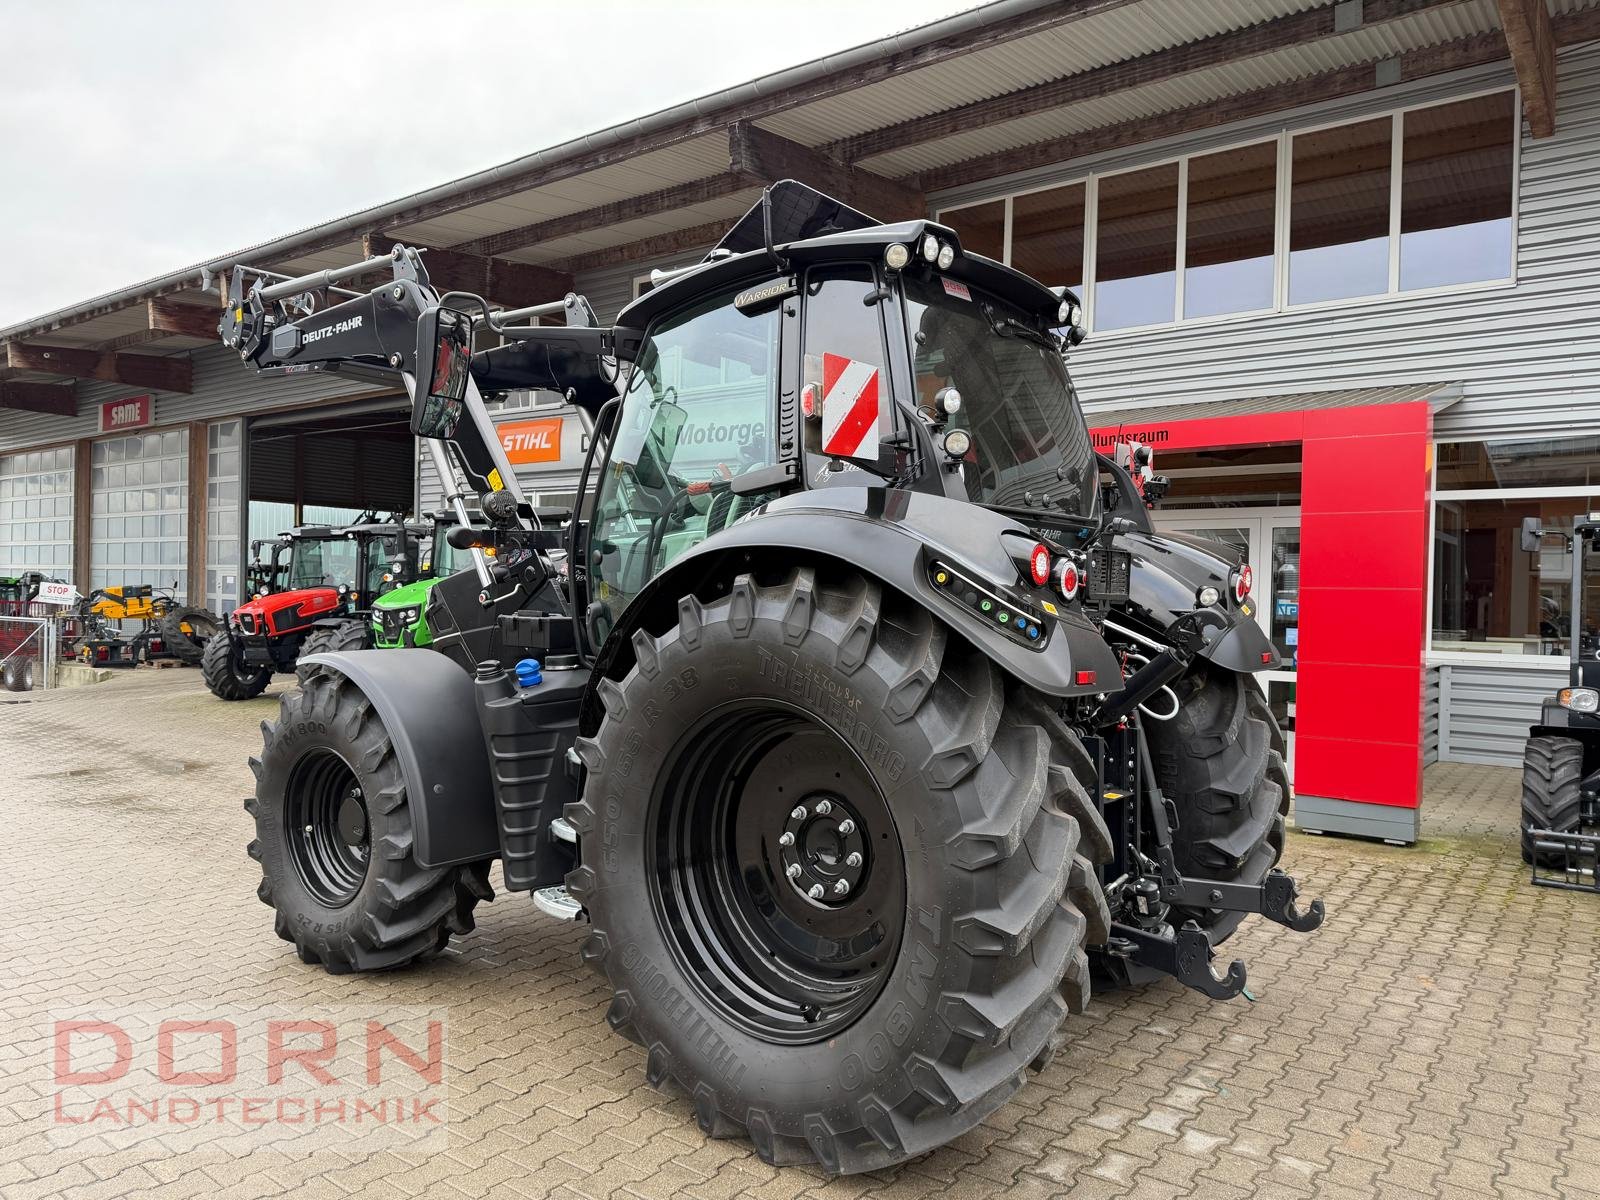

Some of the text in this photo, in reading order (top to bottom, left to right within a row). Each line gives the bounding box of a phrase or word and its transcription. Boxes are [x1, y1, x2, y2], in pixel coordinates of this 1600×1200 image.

[735, 283, 787, 307] WARRIOR
[302, 315, 363, 345] DEUTZ-FAHR
[111, 402, 141, 425] SAME
[503, 432, 552, 452] STIHL
[47, 585, 69, 595] STOP
[662, 665, 699, 701] 38
[757, 644, 906, 782] TRELLEBORG
